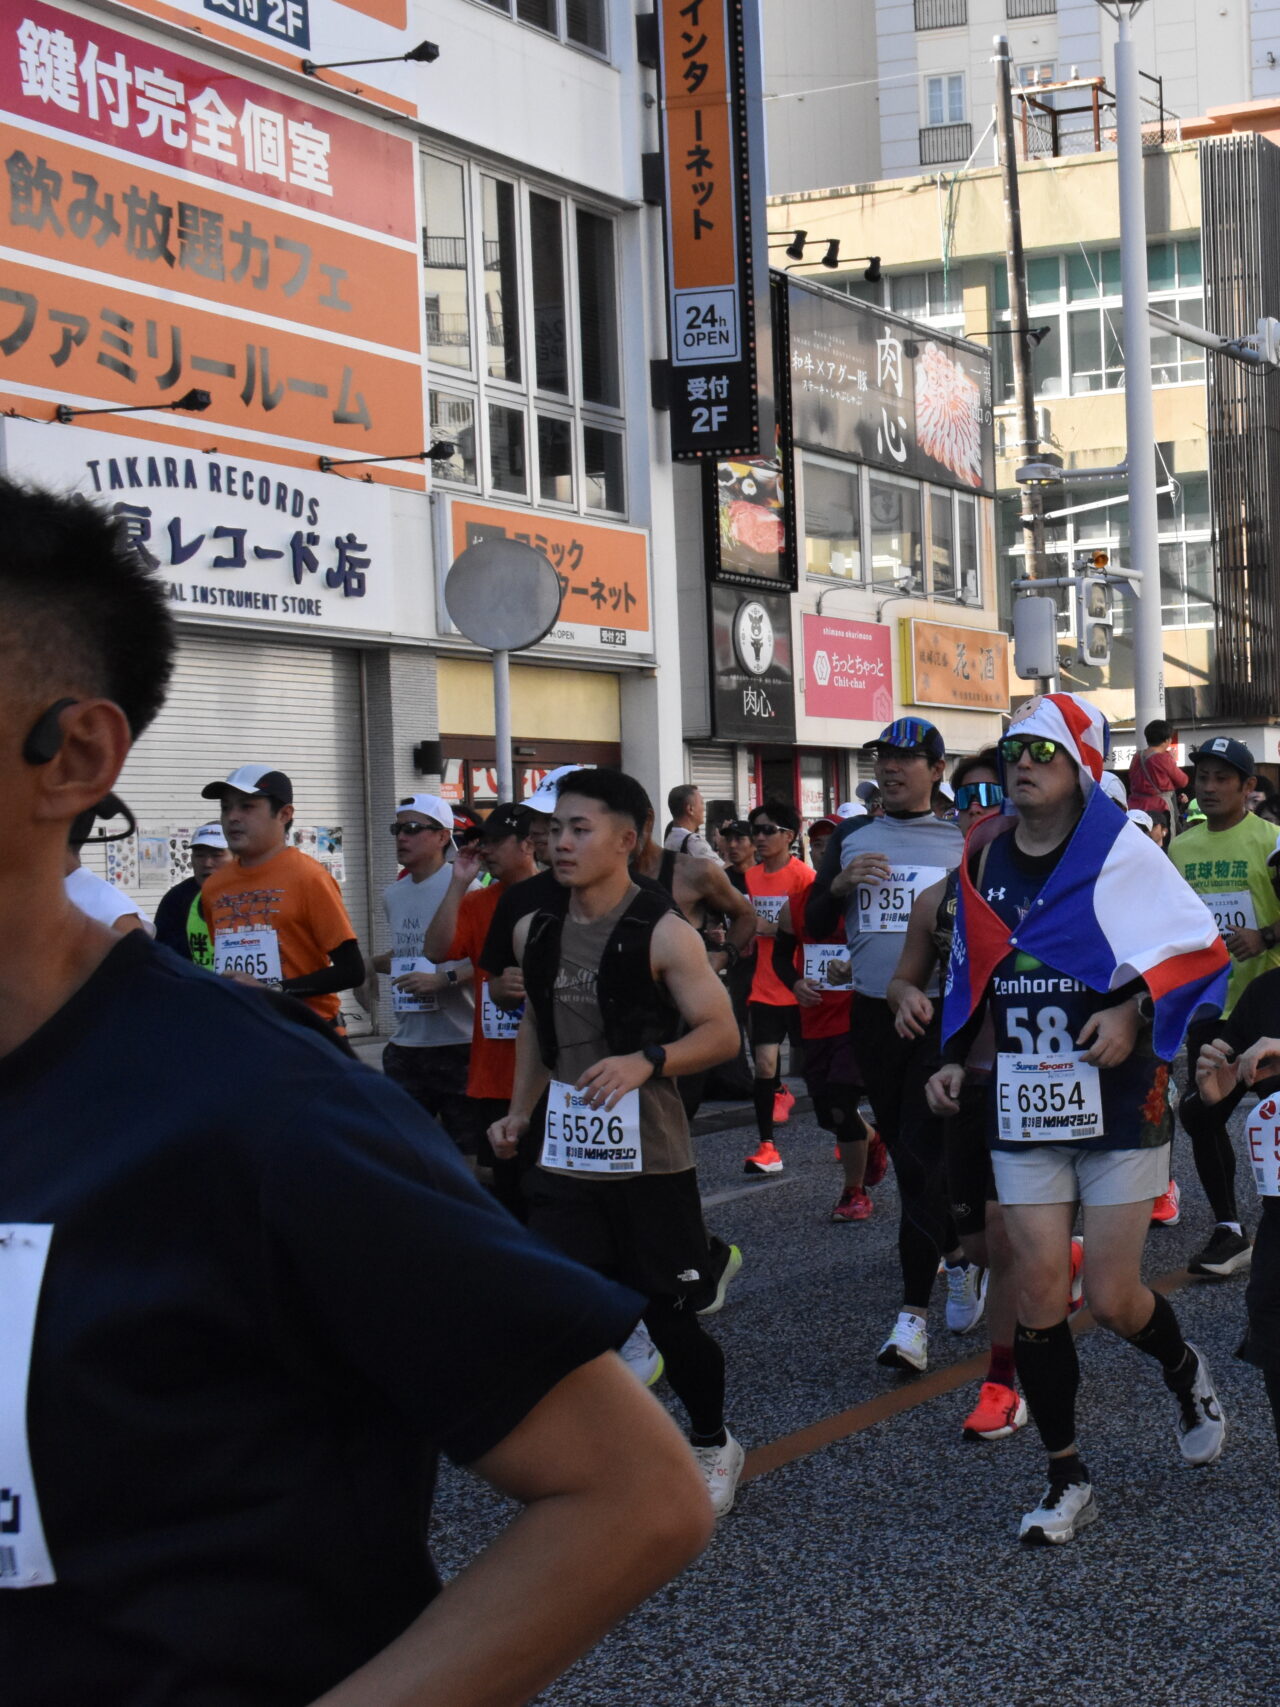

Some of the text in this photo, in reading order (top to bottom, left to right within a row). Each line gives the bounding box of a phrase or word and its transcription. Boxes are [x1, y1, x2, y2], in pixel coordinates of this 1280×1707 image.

[266, 0, 303, 38] 2F
[16, 17, 334, 197] 鍵付完全個室
[4, 149, 353, 313] 飲み放題カフェ
[685, 303, 727, 330] 24h
[683, 329, 730, 347] OPEN
[0, 286, 373, 432] ファミリールーム
[686, 375, 729, 401] 受付
[875, 325, 908, 463] 肉心
[691, 405, 728, 434] 2F
[87, 456, 320, 527] TAKARA RECORDS
[104, 500, 372, 599] 良レコード店
[192, 585, 278, 612] INSTRUMENT
[281, 594, 323, 617] STORE
[557, 630, 575, 641] OPEN
[615, 632, 626, 645] 2F
[831, 652, 885, 678] ちっとちゃっと
[834, 675, 866, 689] Chit-chat
[743, 686, 772, 718] 肉心
[1185, 859, 1249, 881] 琉球物流
[860, 888, 871, 911] D
[402, 919, 420, 929] ANA
[806, 959, 813, 976] E
[483, 1001, 491, 1021] E
[1006, 1005, 1074, 1055] 58
[1015, 1061, 1075, 1071] SUPER SPORTS
[1000, 1081, 1086, 1113] E 6354
[548, 1110, 624, 1145] E 5526
[1248, 1127, 1265, 1162] E
